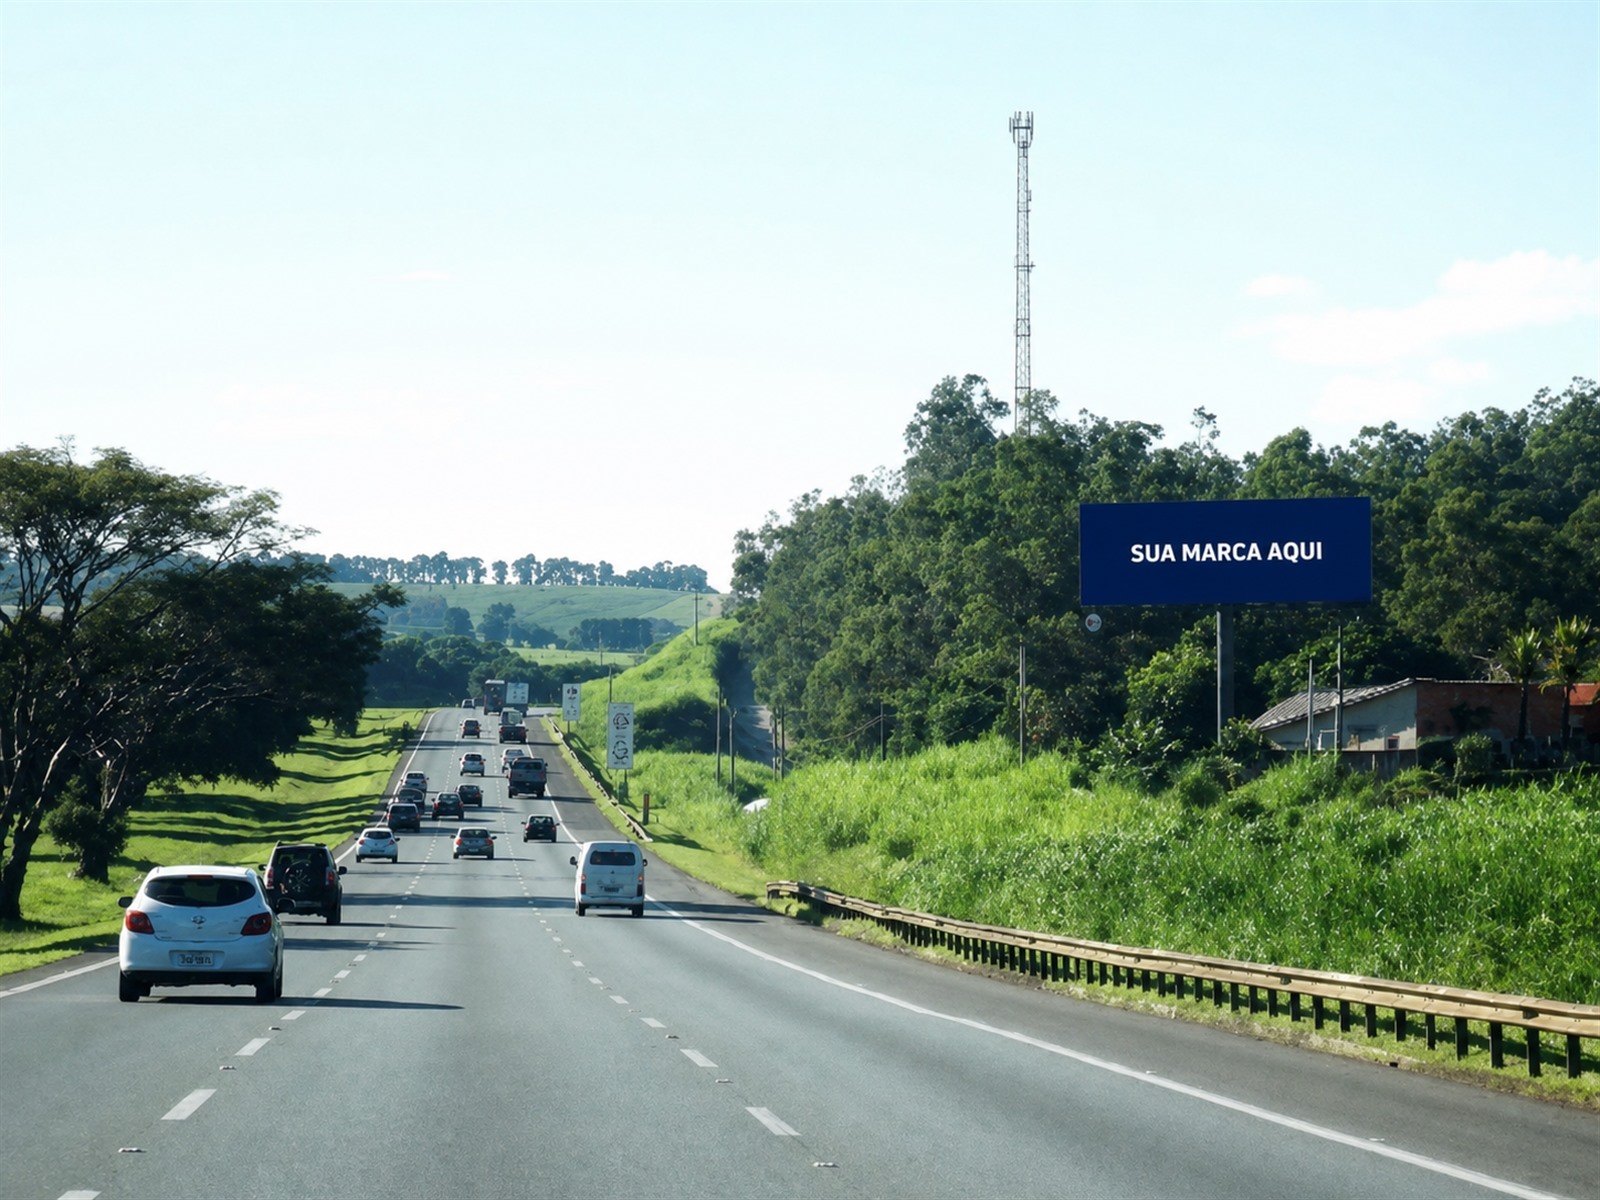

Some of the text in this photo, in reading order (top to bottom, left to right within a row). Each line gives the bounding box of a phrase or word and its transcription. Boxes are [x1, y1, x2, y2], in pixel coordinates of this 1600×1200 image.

[1130, 541, 1323, 563] SUA MARCA AQUI
